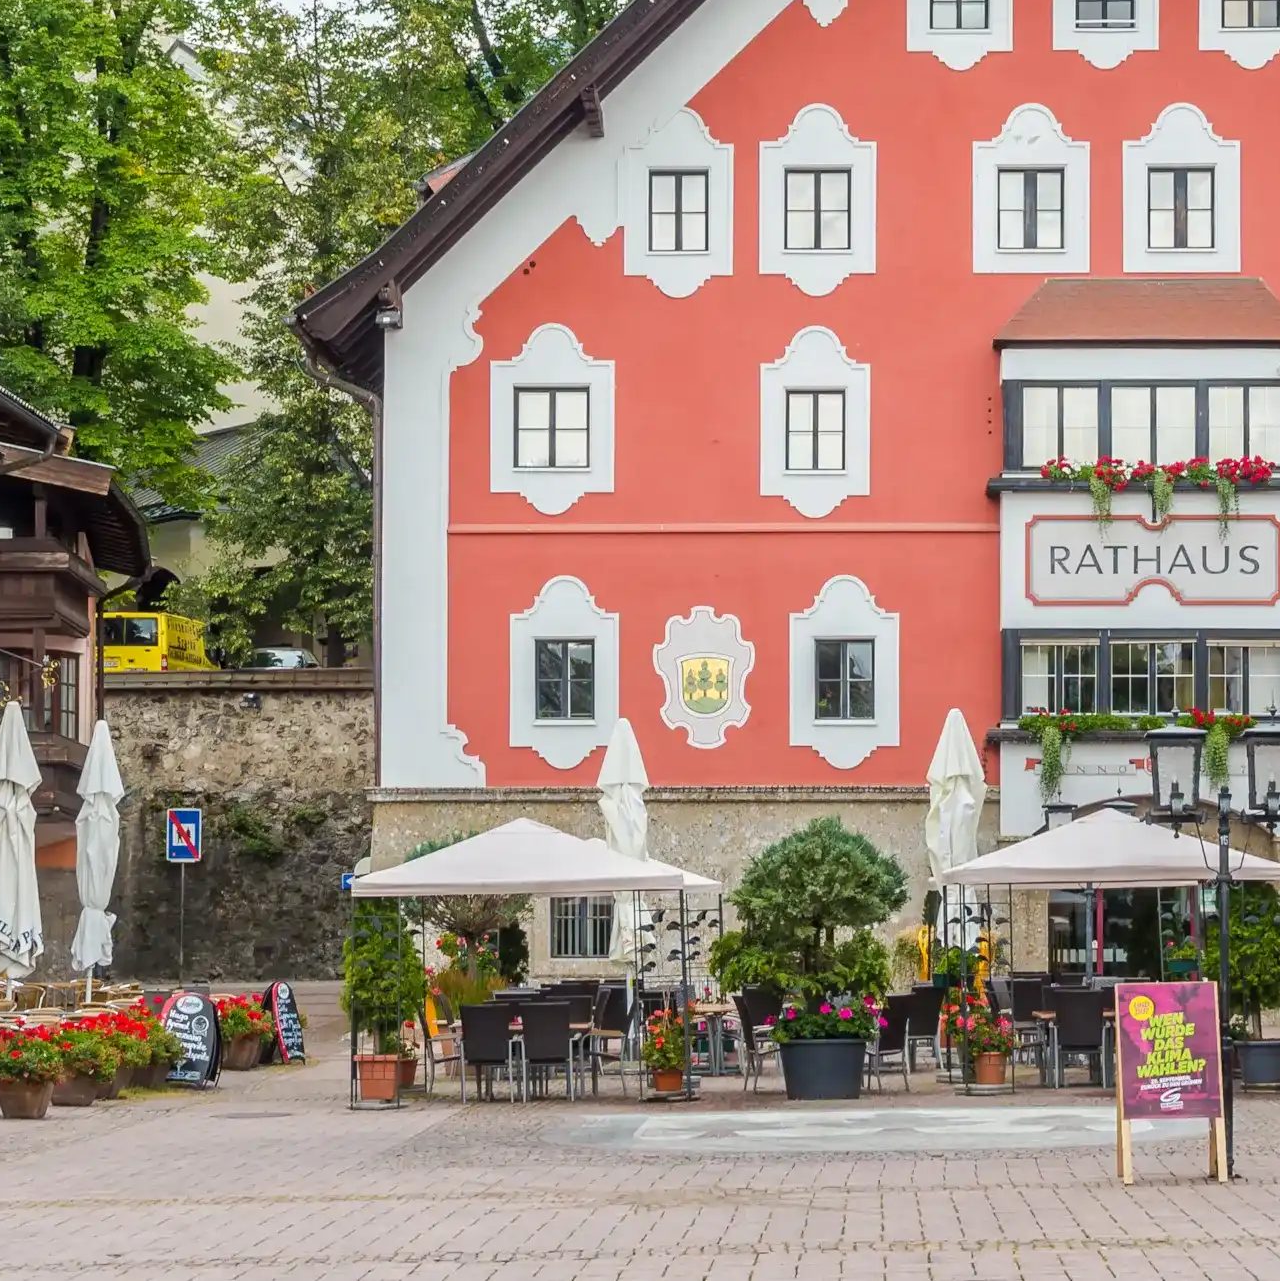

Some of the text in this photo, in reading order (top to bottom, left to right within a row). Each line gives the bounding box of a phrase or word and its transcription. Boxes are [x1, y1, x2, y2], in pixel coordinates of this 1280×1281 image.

[1049, 544, 1260, 575] RATHAUS
[1149, 1012, 1183, 1027] WEN
[1155, 1037, 1184, 1050] DAS
[1146, 1048, 1192, 1064] KLIMA
